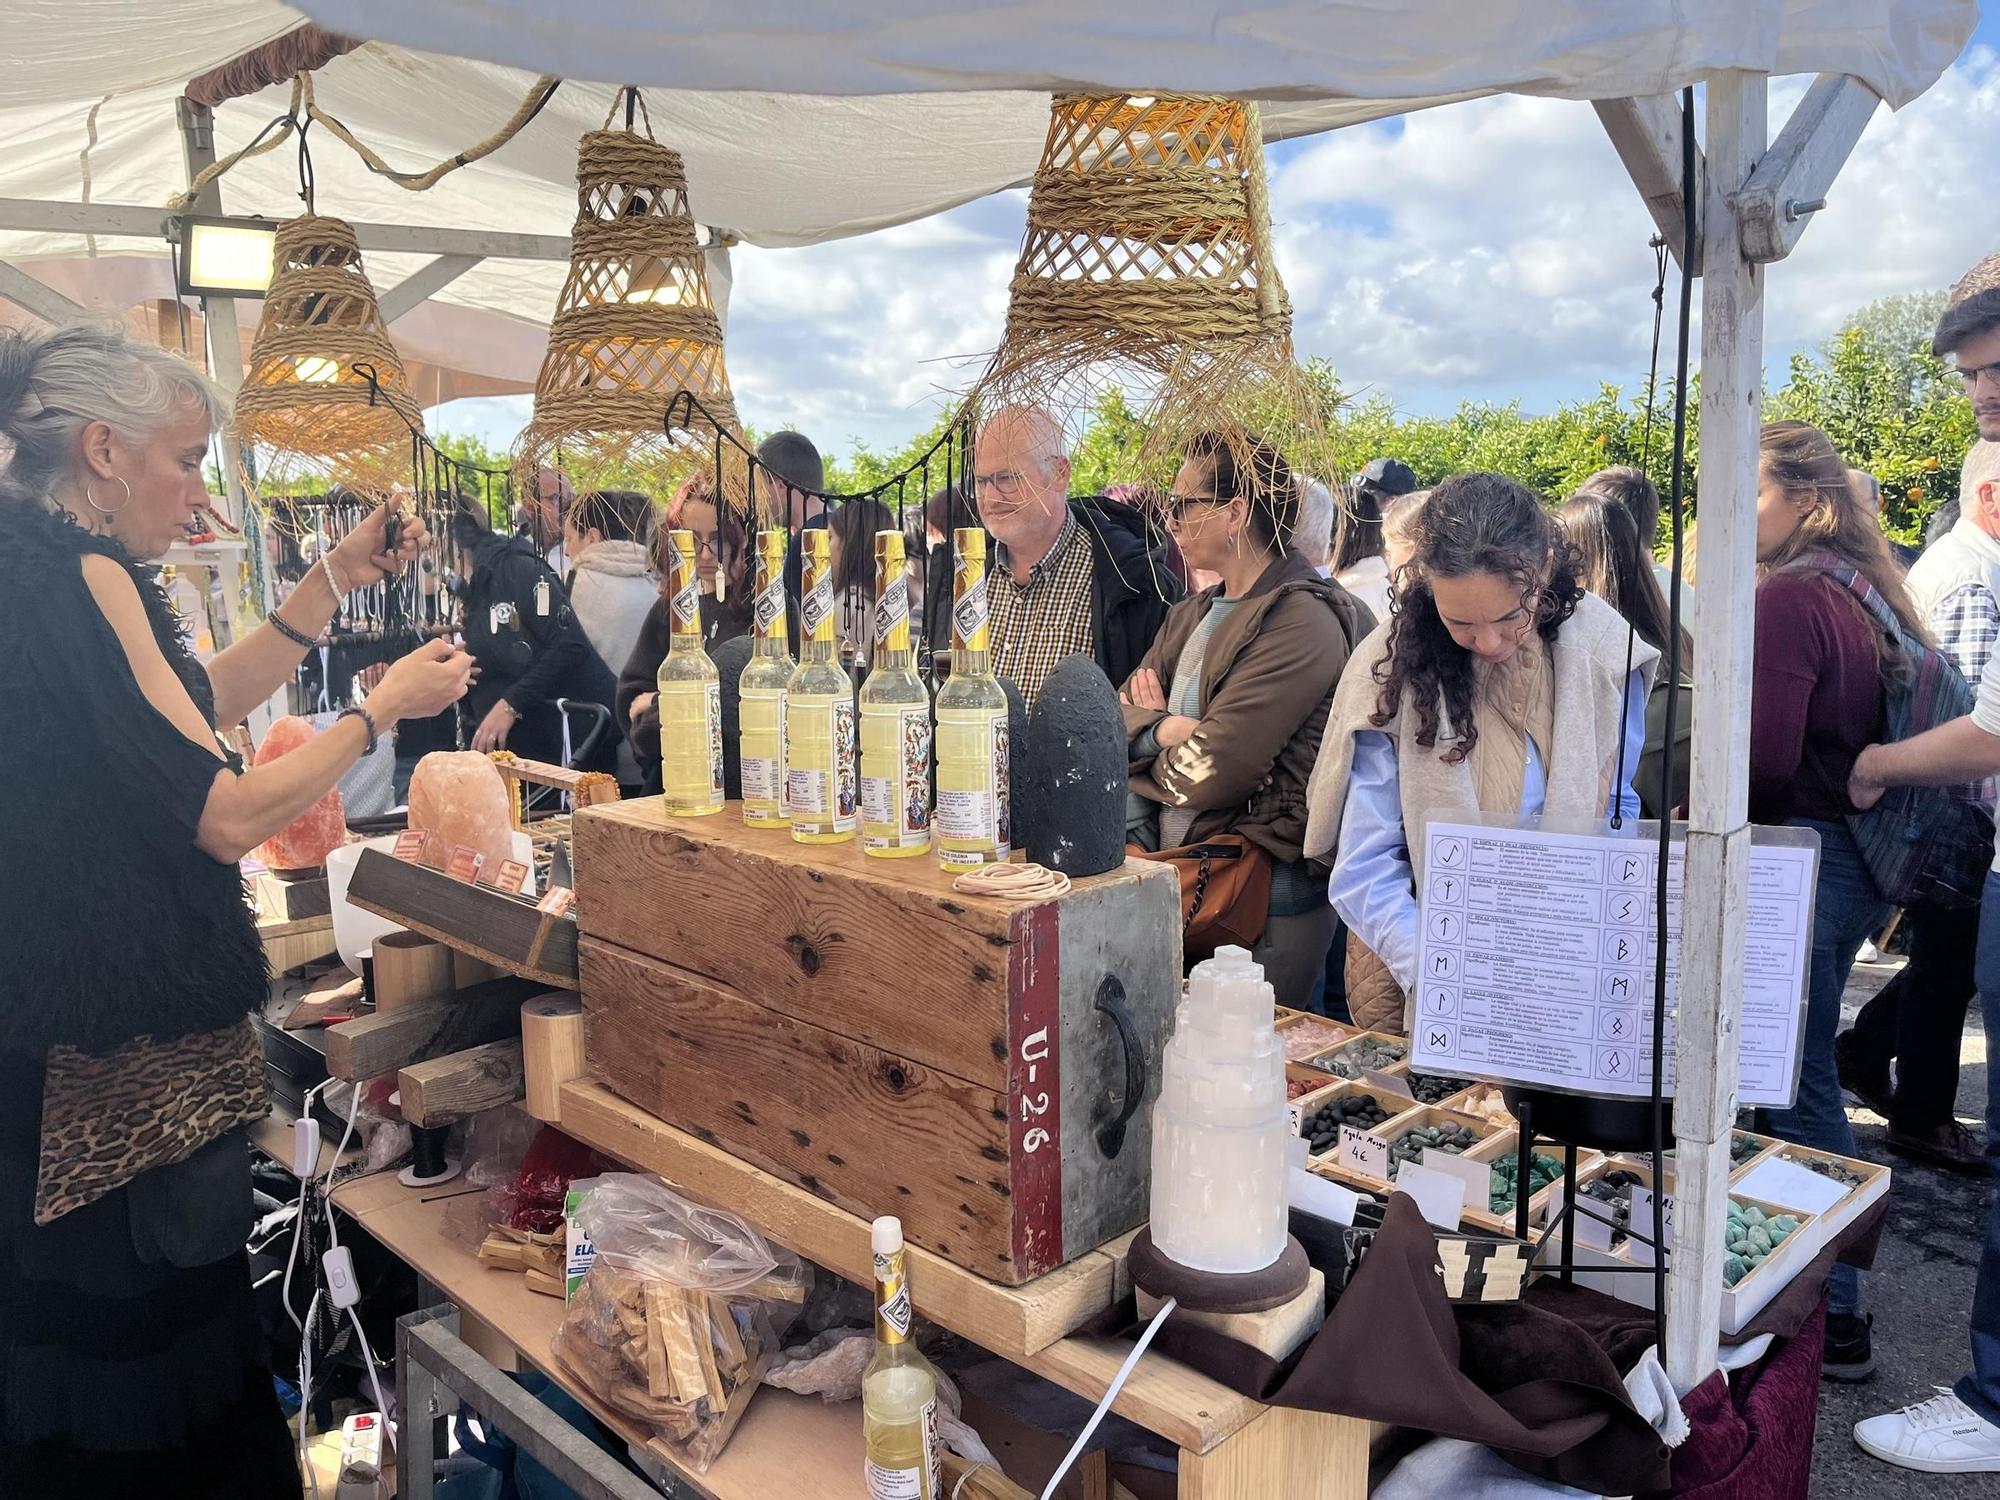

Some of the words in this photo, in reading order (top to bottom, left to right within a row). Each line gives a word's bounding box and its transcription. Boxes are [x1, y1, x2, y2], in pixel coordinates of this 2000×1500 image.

[1020, 1025, 1050, 1154] U-26
[1351, 1145, 1368, 1162] 4€
[1952, 1427, 1979, 1436] Reebok
